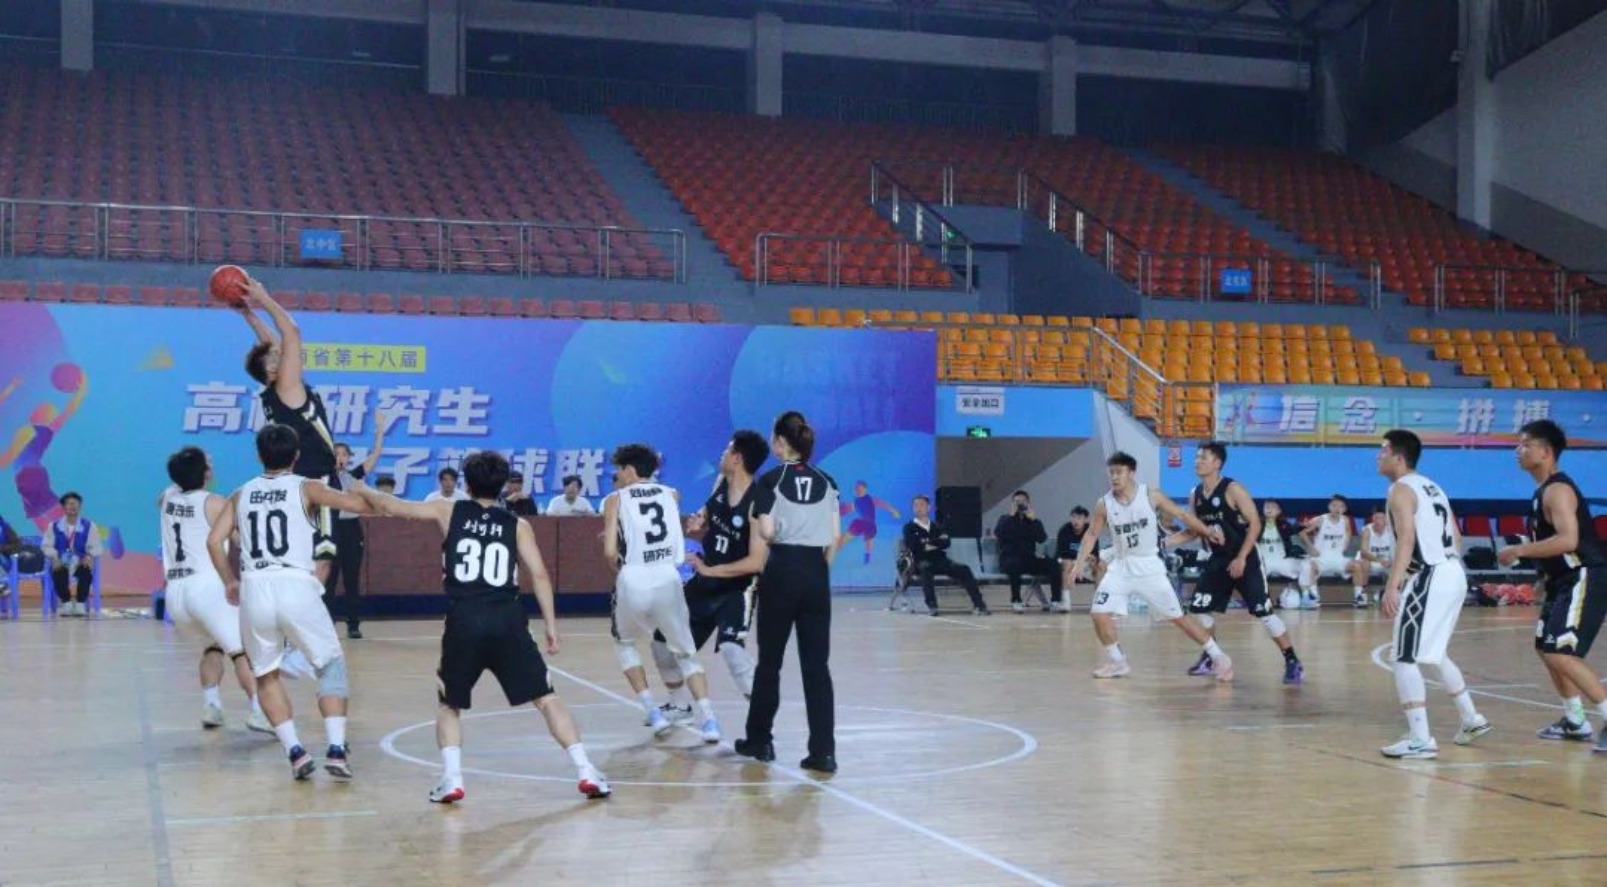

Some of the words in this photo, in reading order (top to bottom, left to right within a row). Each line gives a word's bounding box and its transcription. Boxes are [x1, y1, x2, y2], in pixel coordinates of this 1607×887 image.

[182, 381, 490, 435] 高研究生
[794, 476, 813, 501] 17
[172, 522, 186, 562] 1
[248, 509, 289, 559] 10
[639, 501, 668, 544] 3
[714, 534, 729, 554] 11
[1433, 503, 1453, 548] 2
[454, 538, 510, 587] 30
[1192, 592, 1212, 607] 29
